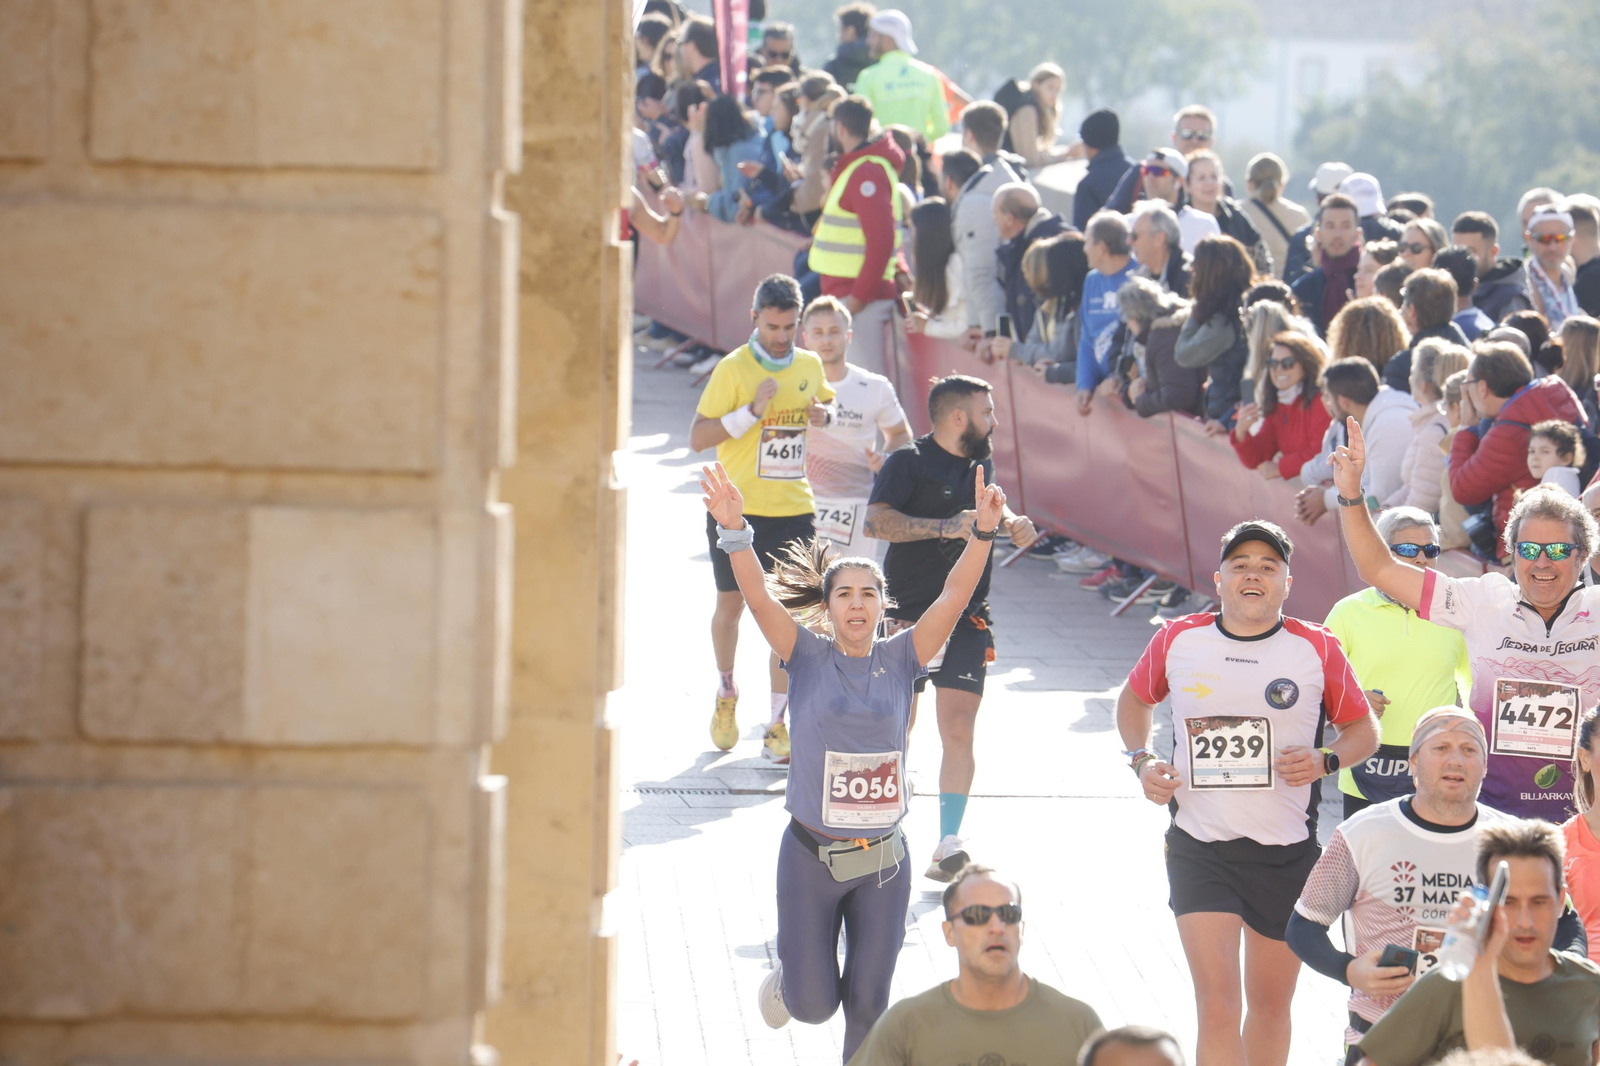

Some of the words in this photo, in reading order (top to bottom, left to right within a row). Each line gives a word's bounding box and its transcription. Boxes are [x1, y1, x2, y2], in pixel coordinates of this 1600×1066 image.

[836, 410, 862, 420] ATÓN
[766, 444, 802, 459] 4619
[818, 509, 851, 526] 742
[1540, 645, 1552, 653] DE
[1550, 639, 1595, 656] SEGURA
[1225, 656, 1259, 664] EVERNYA
[1500, 702, 1573, 730] 4472
[1195, 735, 1264, 759] 2939
[831, 775, 898, 800] 5056
[1520, 792, 1575, 801] BUJARKAY
[1422, 873, 1473, 887] MEDIA
[1394, 886, 1416, 903] 37
[1422, 908, 1449, 919] CÓR
